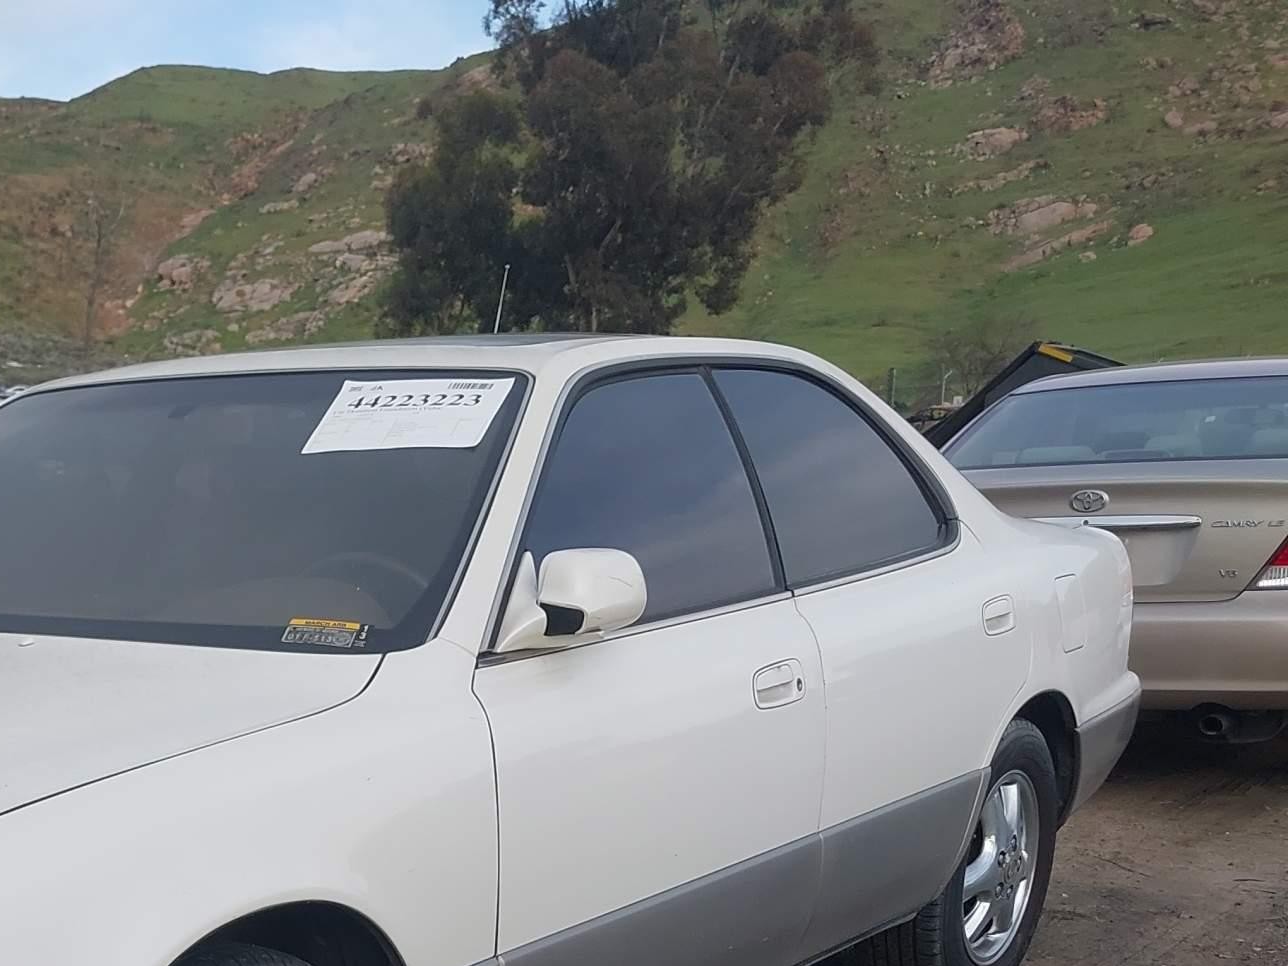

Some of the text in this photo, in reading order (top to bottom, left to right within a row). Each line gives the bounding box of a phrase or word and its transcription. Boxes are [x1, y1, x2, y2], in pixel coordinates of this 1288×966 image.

[347, 393, 483, 409] 44223223
[1210, 519, 1265, 529] CAMRY
[1218, 568, 1239, 579] V6
